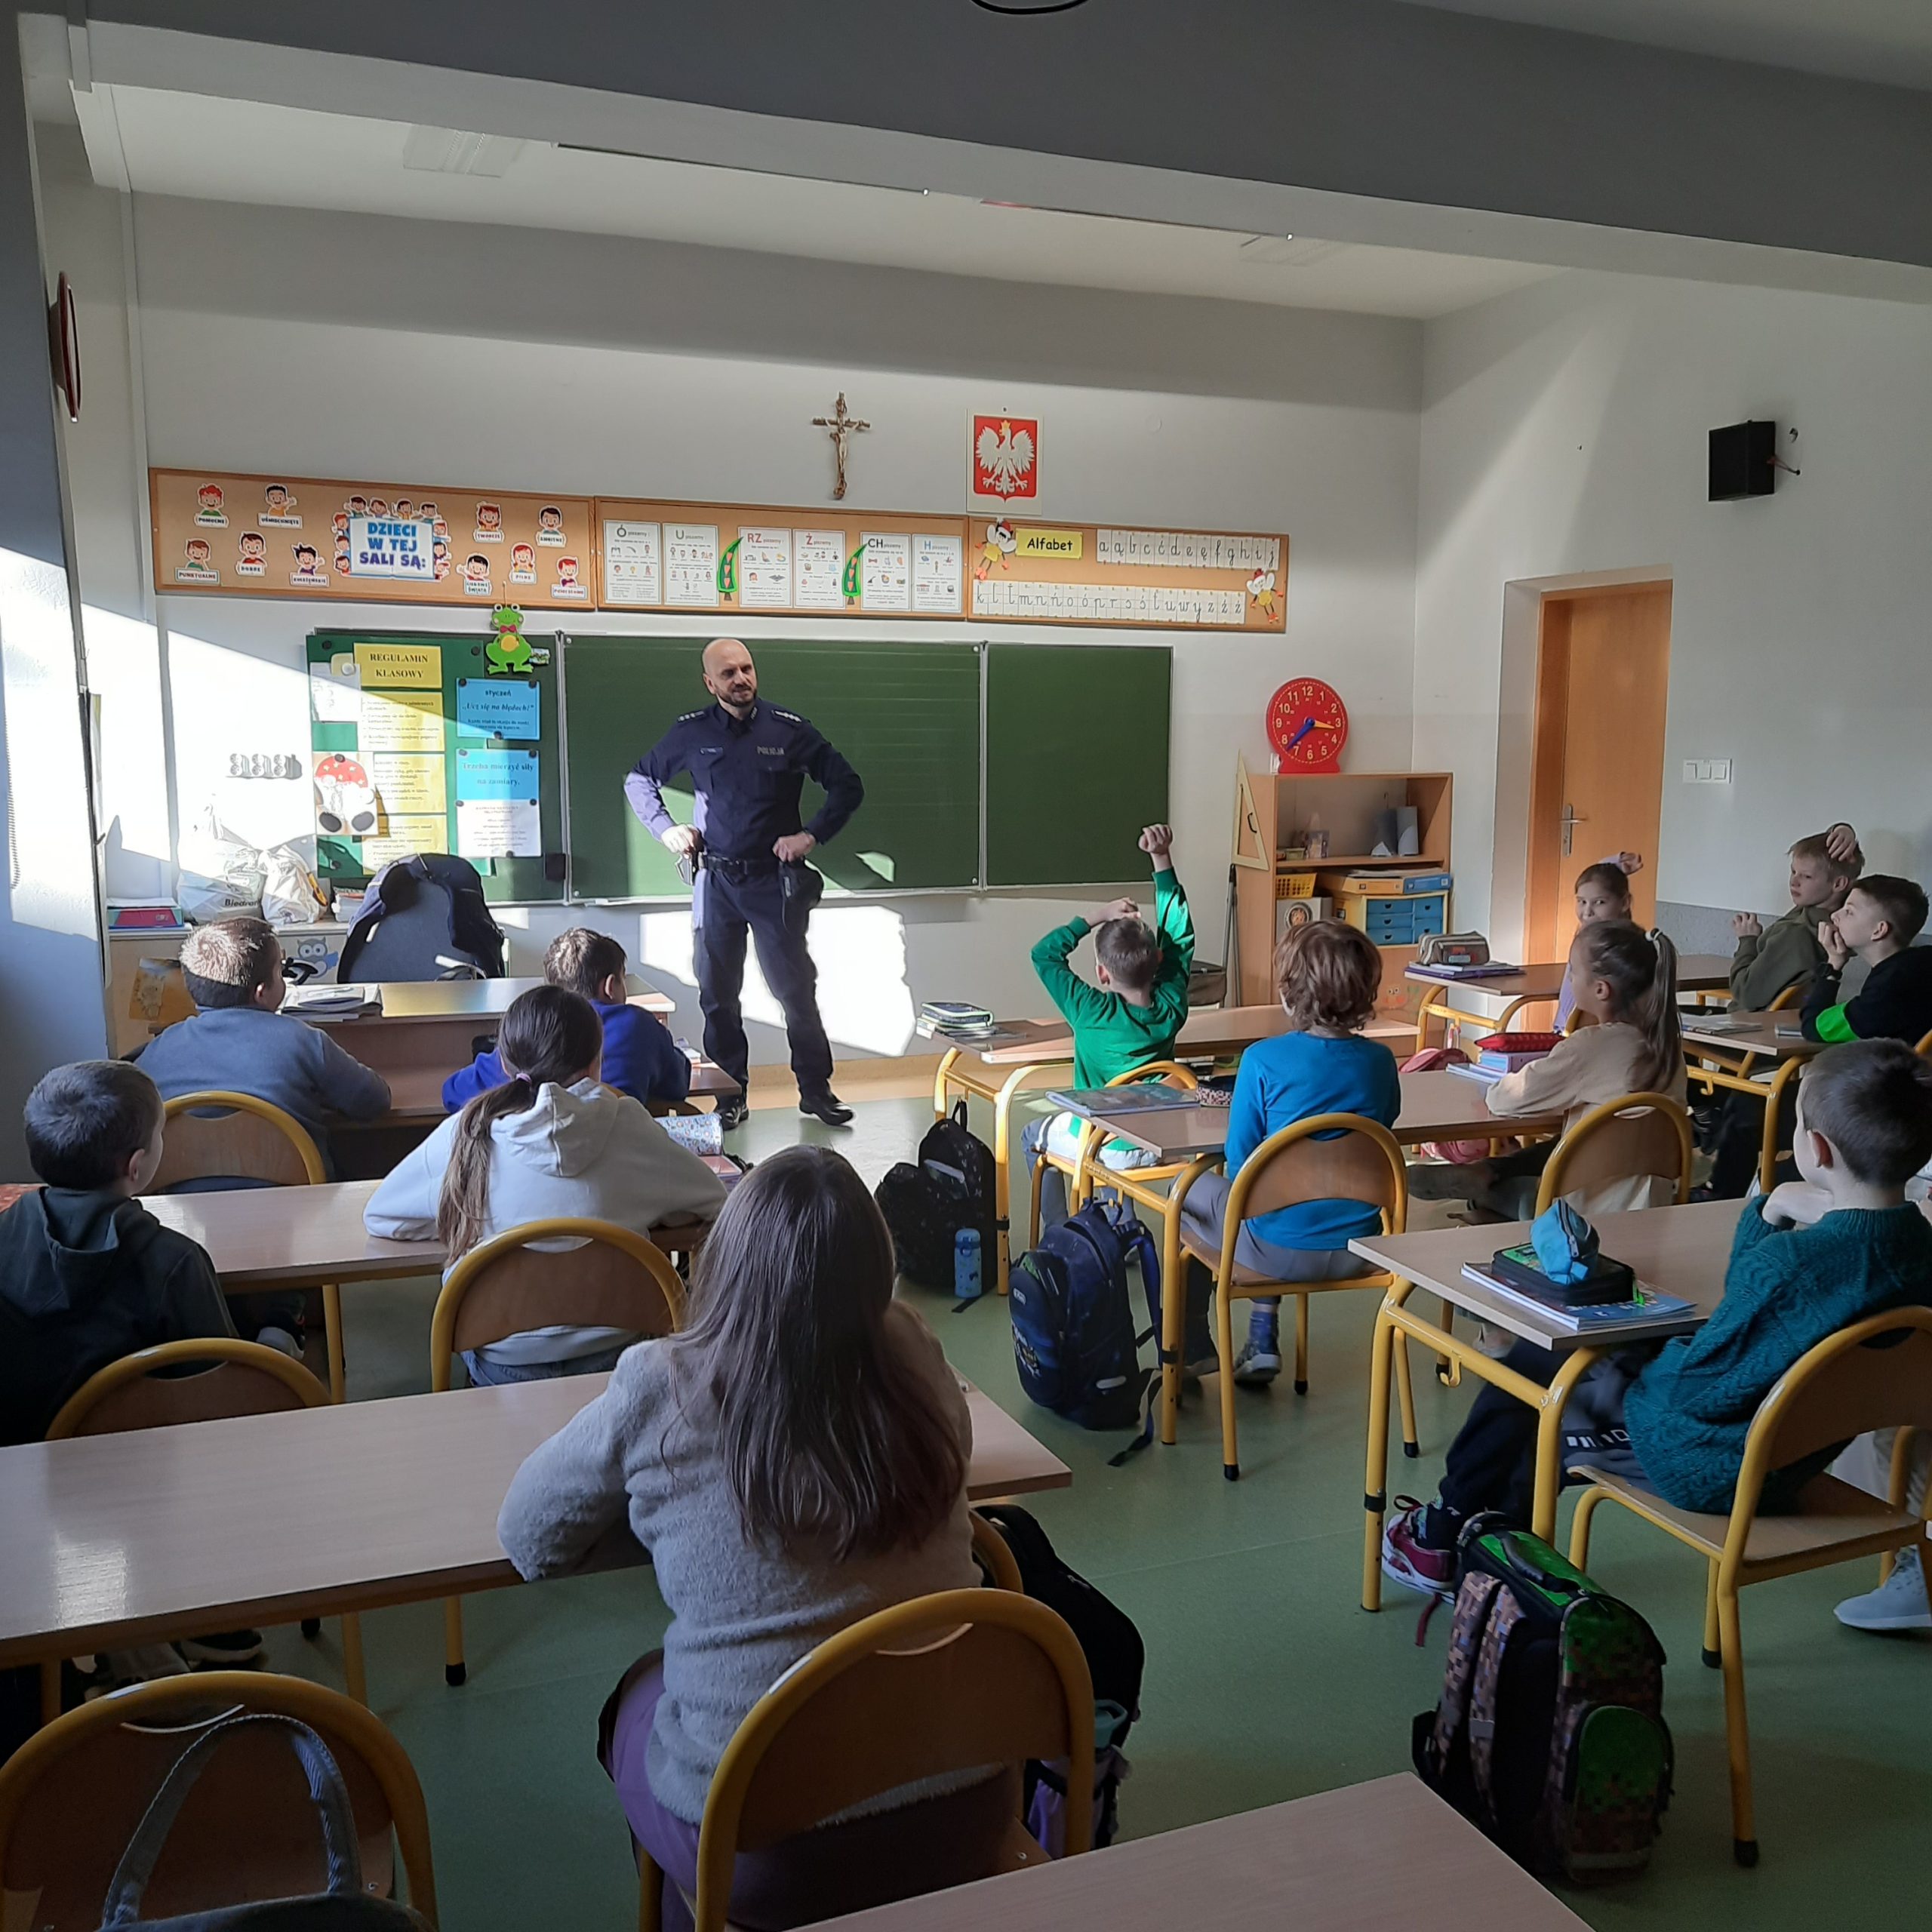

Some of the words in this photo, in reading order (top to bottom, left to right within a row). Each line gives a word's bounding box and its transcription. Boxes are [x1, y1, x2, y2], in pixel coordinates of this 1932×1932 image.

[368, 522, 417, 537] DZIECI
[675, 529, 685, 540] U
[747, 533, 762, 543] RZ
[368, 537, 383, 549] W
[389, 539, 417, 552] TEJ
[868, 538, 884, 549] CH
[924, 540, 932, 550] H
[1026, 537, 1073, 552] Alfabet
[1099, 541, 1109, 552] a
[1129, 535, 1137, 553] b
[1143, 544, 1151, 555] c
[1171, 537, 1181, 555] d
[1186, 546, 1193, 557] e
[1215, 539, 1221, 564] f
[1227, 549, 1235, 566] g
[1240, 540, 1251, 560] h
[1255, 546, 1263, 560] i
[1269, 546, 1275, 568] j
[359, 552, 395, 565] SALI
[401, 554, 426, 571] SĄ:
[977, 584, 985, 604] k
[992, 583, 999, 603] l
[1019, 595, 1033, 605] m
[1035, 595, 1048, 606] n
[1067, 597, 1074, 607] o
[1094, 598, 1106, 617] p
[1109, 598, 1118, 608] r
[1152, 592, 1160, 611] t
[1164, 601, 1175, 612] u
[1178, 601, 1190, 612] w
[1192, 601, 1201, 623] y
[1208, 602, 1214, 613] z
[370, 653, 429, 663] REGULAMIN
[376, 669, 423, 678] KLASOWY
[1302, 685, 1314, 696] 12
[1287, 691, 1299, 701] 11
[1320, 691, 1324, 701] 1
[1278, 703, 1291, 713] 10
[1331, 703, 1337, 713] 2
[1275, 718, 1282, 728] 9
[1335, 718, 1342, 728] 3
[1281, 734, 1288, 745] 8
[1331, 734, 1337, 744] 4
[757, 746, 786, 755] POLICJA
[1293, 746, 1300, 756] 7
[1306, 749, 1314, 760] 6
[1321, 746, 1327, 755] 5
